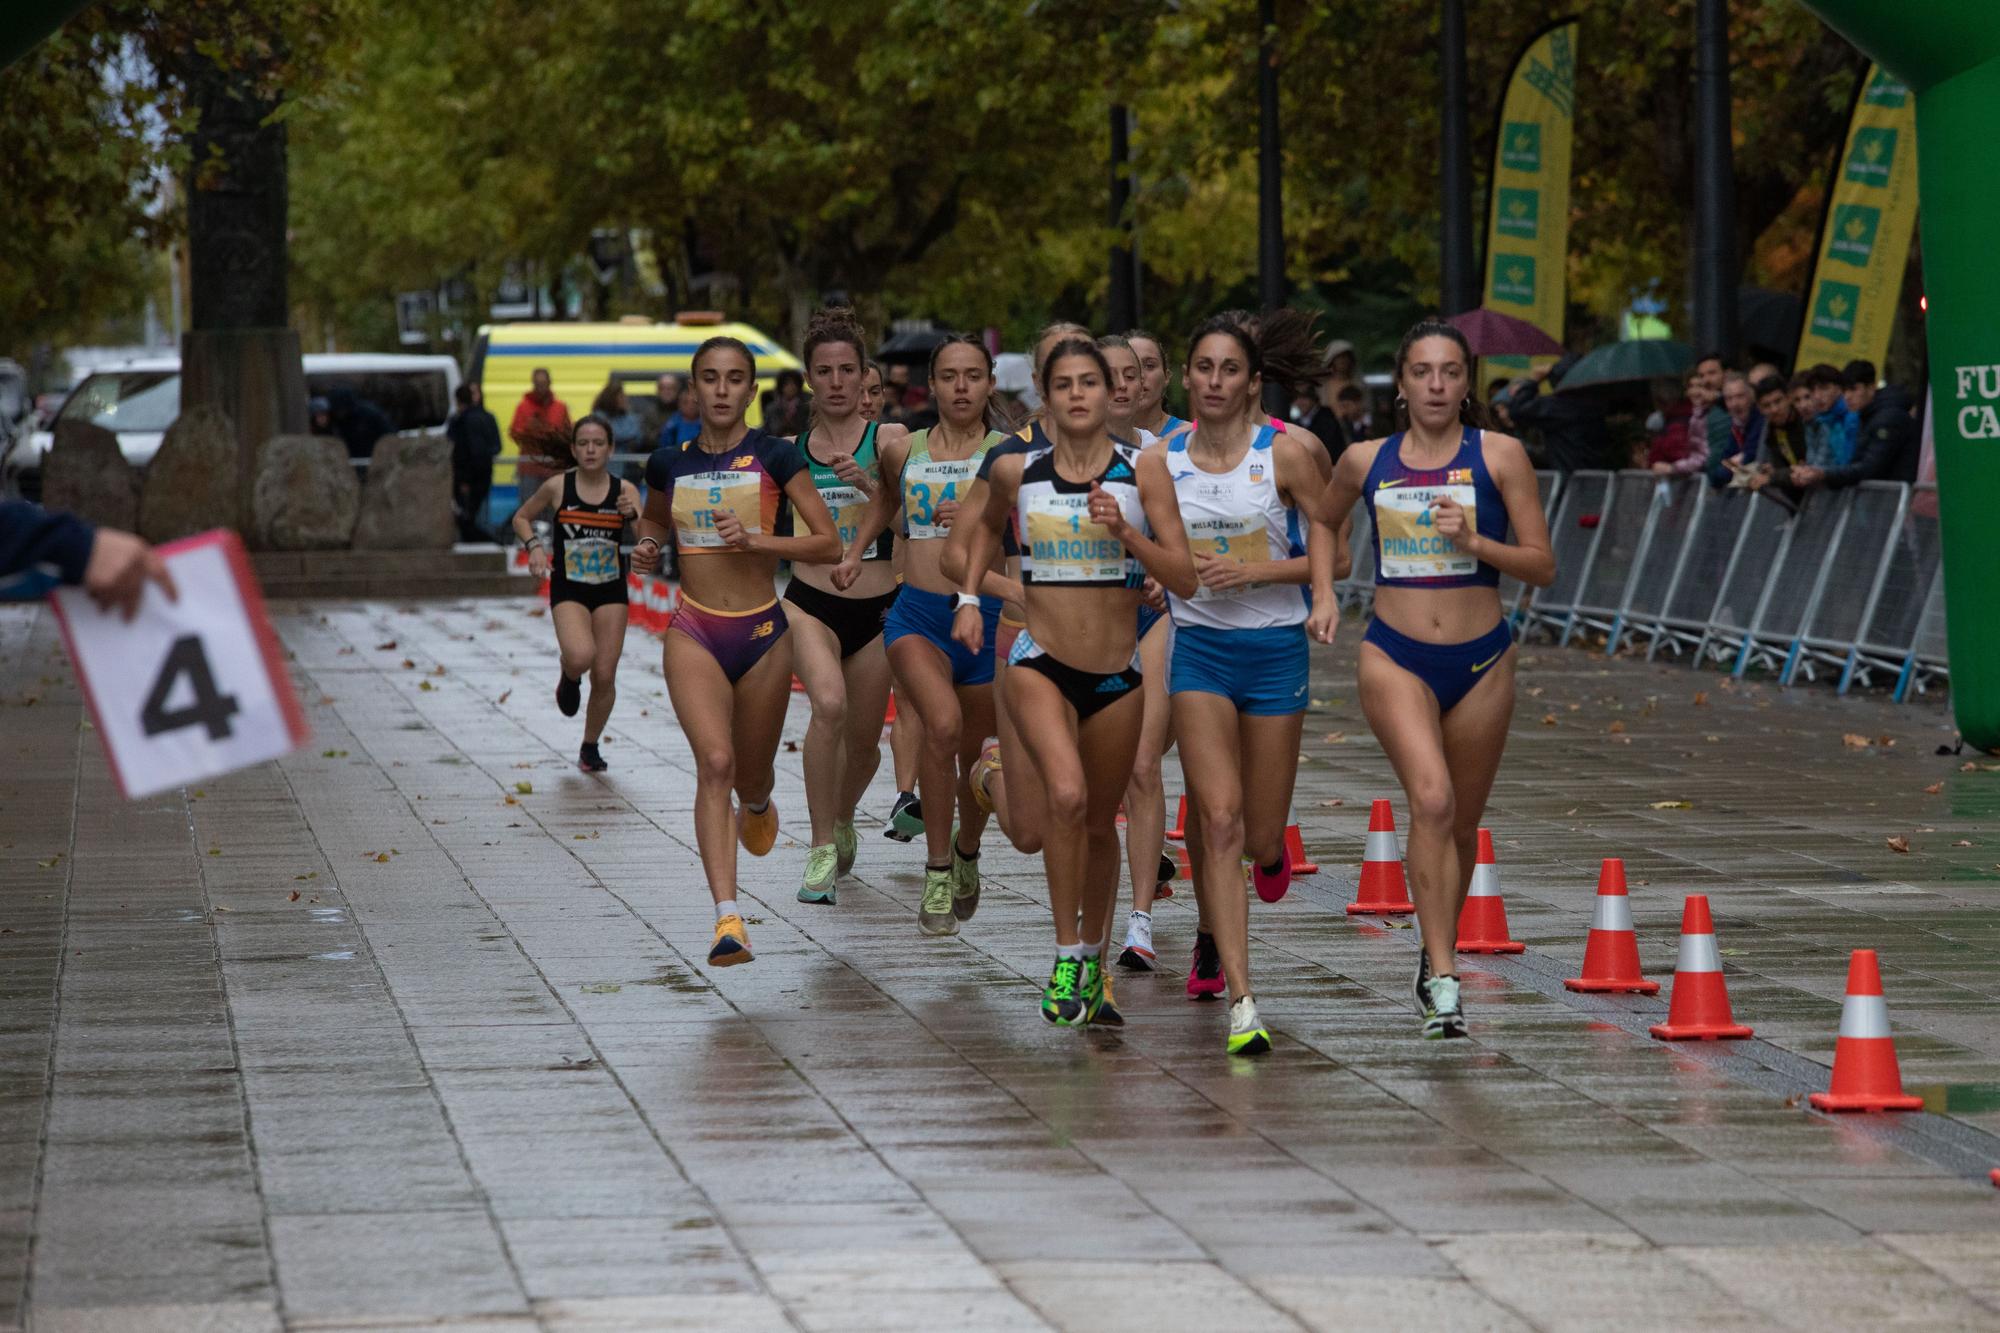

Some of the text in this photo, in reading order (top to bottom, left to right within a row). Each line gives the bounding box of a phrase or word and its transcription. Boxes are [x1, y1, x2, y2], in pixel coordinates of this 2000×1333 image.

[1955, 363, 2000, 400] FU
[1957, 404, 2000, 440] CA
[708, 487, 722, 504] 5
[822, 491, 854, 501] AZAMORA
[1069, 515, 1079, 534] 1
[1416, 509, 1432, 528] 4
[582, 528, 613, 538] VICKY
[1033, 539, 1121, 561] MARQUES
[1215, 536, 1229, 555] 3
[1383, 537, 1454, 556] PINACCH
[568, 545, 617, 577] 342
[140, 634, 239, 741] 4
